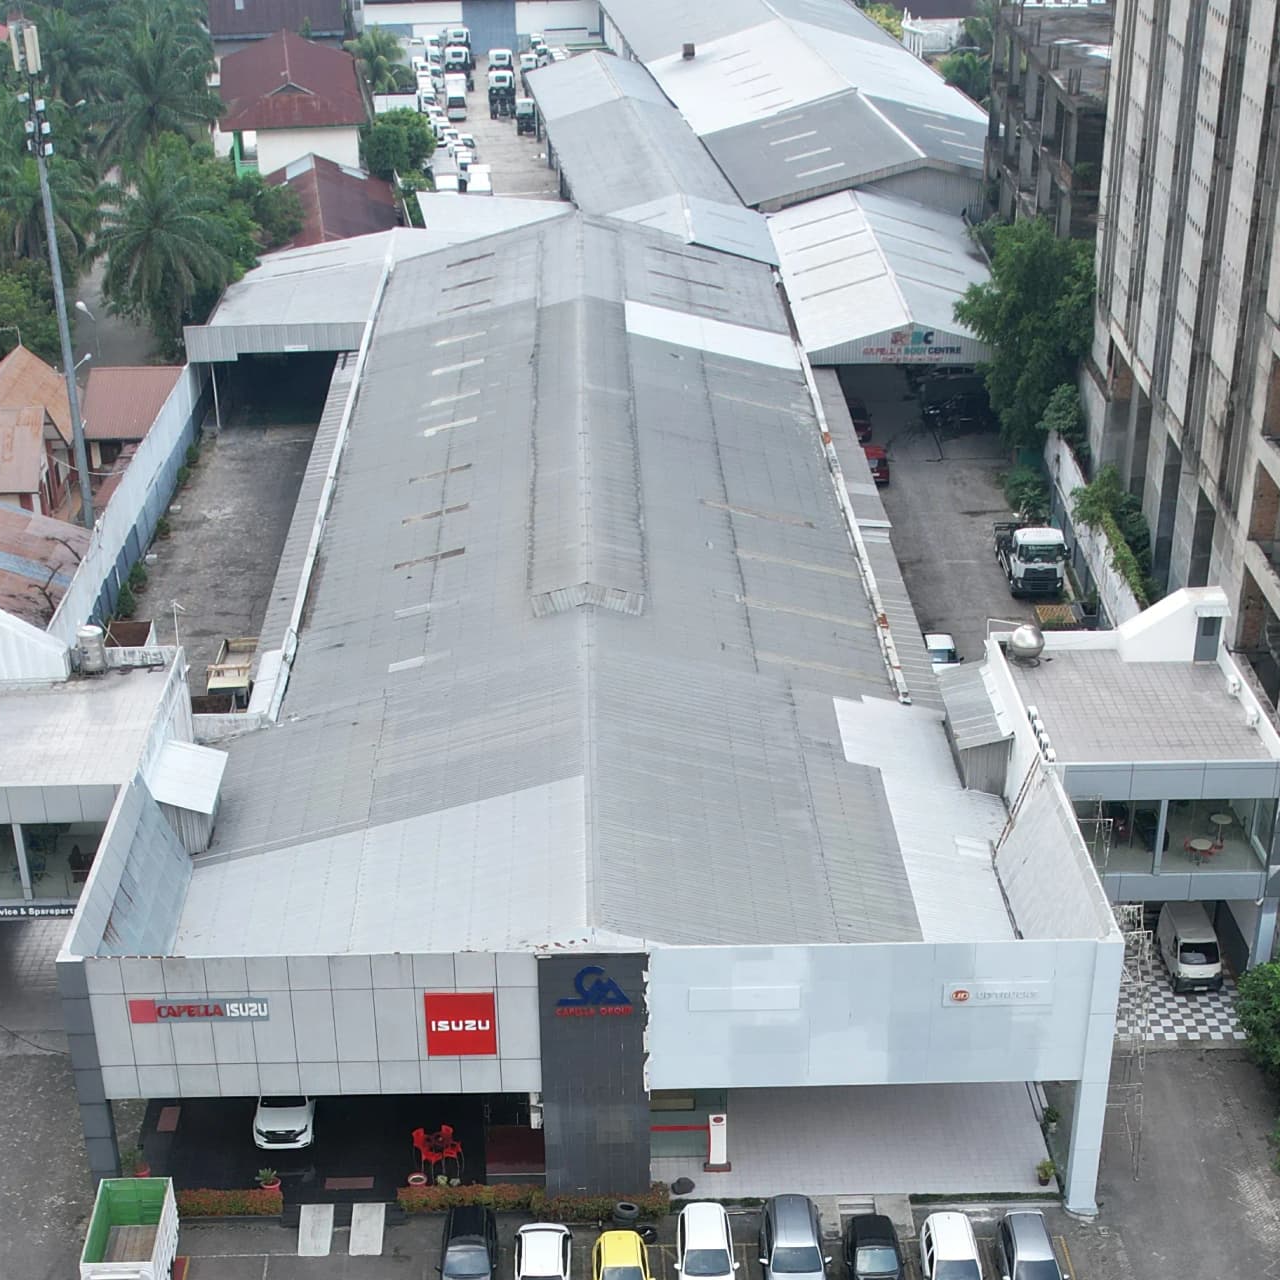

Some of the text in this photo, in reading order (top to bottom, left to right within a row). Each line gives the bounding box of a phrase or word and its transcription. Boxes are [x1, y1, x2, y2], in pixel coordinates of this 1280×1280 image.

[928, 346, 961, 354] CENTRE
[20, 907, 27, 915] &
[157, 1002, 268, 1019] CAPELLA ISUZU
[431, 1019, 491, 1032] ISUZU
